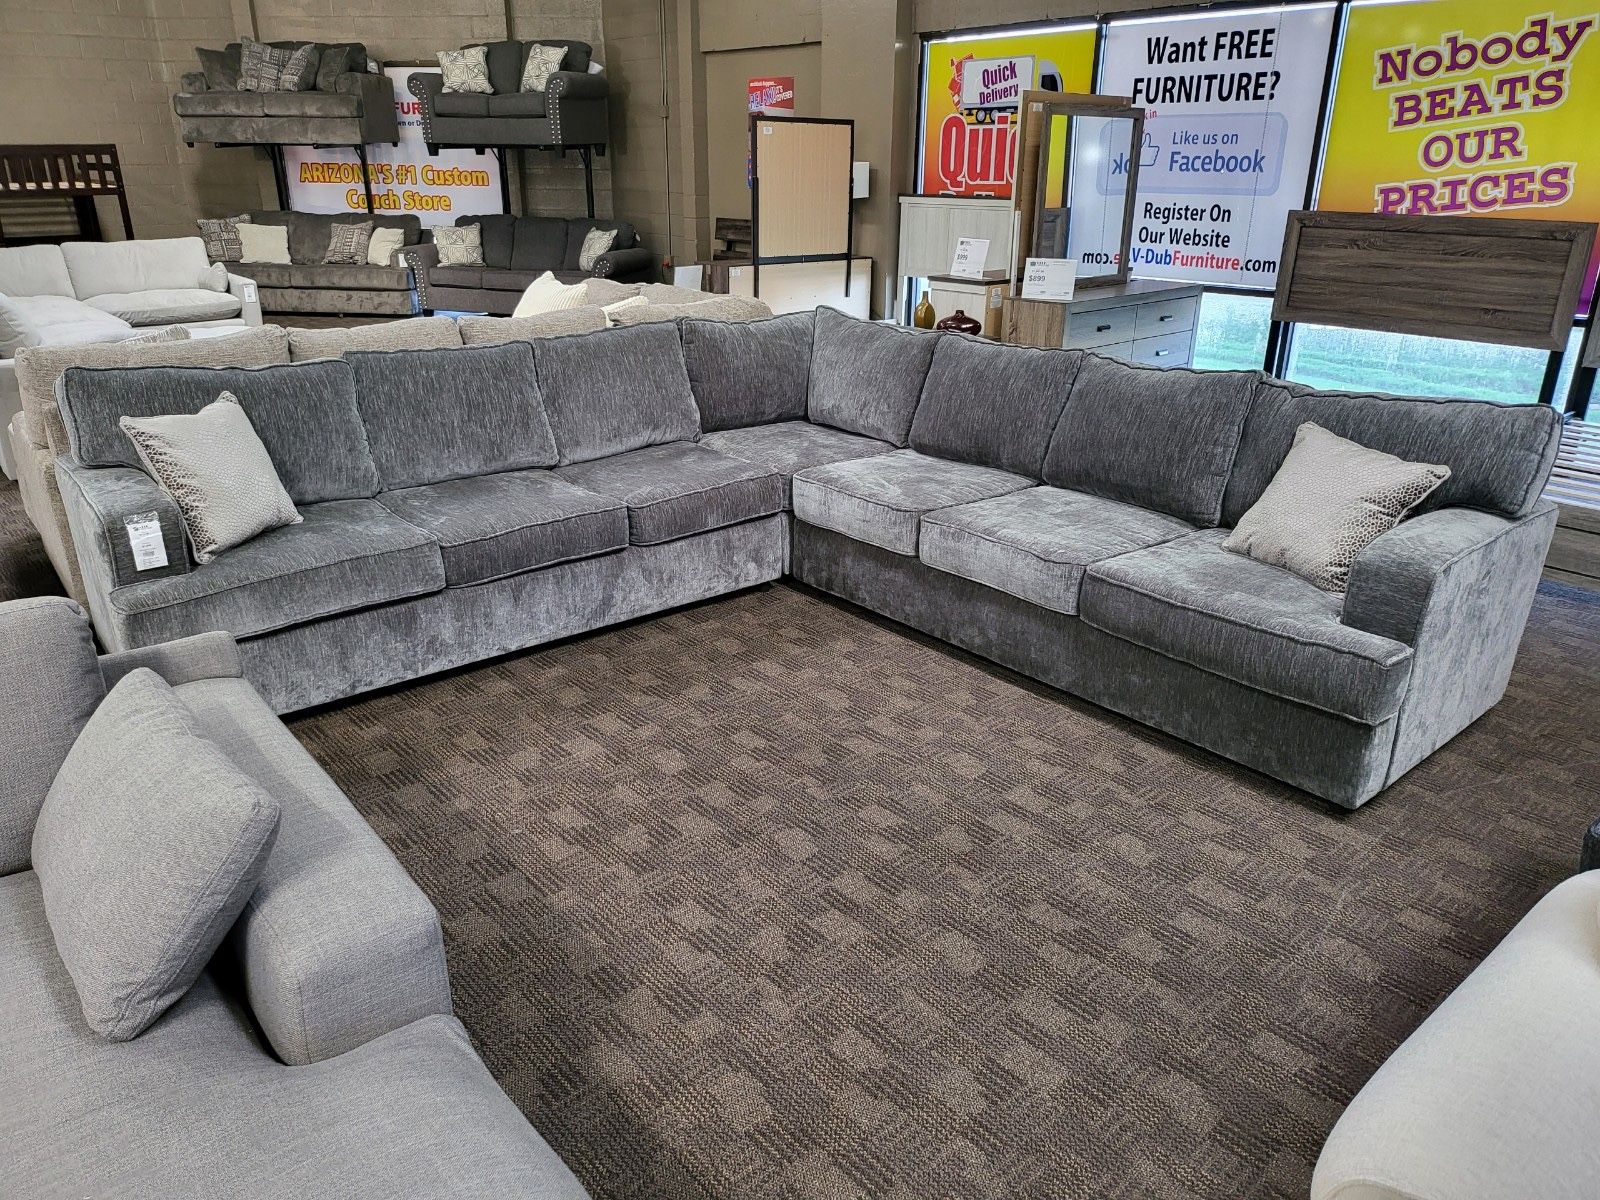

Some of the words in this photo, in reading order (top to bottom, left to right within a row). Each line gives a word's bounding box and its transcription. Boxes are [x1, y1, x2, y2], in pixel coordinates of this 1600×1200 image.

[1147, 35, 1208, 65] Want
[1213, 28, 1276, 61] FREE
[1376, 17, 1594, 86] Nobody
[982, 60, 1018, 89] Quick
[1132, 70, 1281, 104] FURNITURE?
[979, 83, 1019, 105] Delivery
[1391, 67, 1567, 128] BEATS
[1172, 131, 1199, 145] Like
[1202, 133, 1218, 145] us
[1221, 133, 1239, 145] on
[1421, 125, 1524, 169] OUR
[300, 162, 394, 185] ARIZONA'S
[396, 164, 417, 185] #1
[422, 165, 489, 186] Custom
[1169, 149, 1266, 174] Facebook
[346, 189, 401, 210] Couch
[403, 190, 451, 211] Store
[1377, 165, 1572, 215] PRICES
[1143, 202, 1206, 225] Register
[1210, 204, 1231, 222] On
[1139, 226, 1165, 244] Our
[1169, 228, 1231, 248] Website
